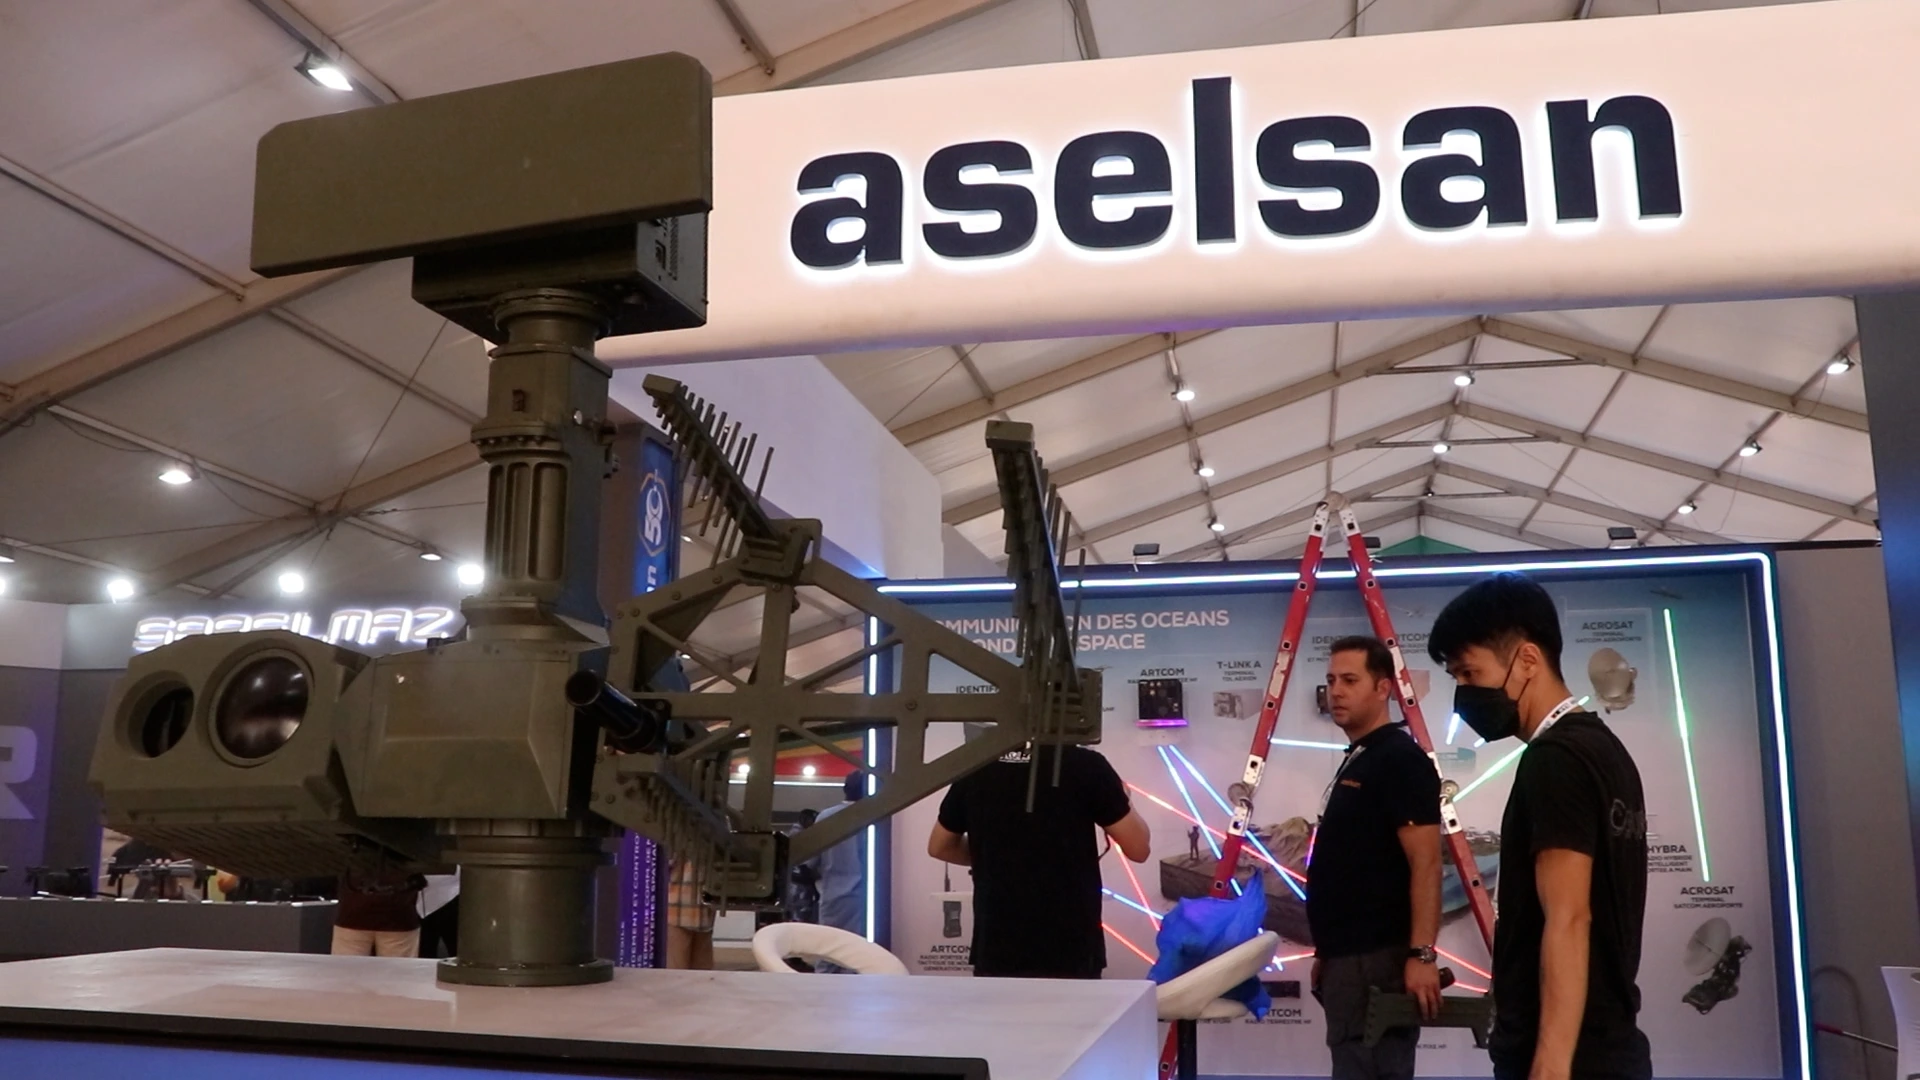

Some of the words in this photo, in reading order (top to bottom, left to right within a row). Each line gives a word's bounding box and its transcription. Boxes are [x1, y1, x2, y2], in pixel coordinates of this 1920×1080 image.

[789, 76, 1682, 269] aselsan
[1097, 613, 1137, 630] DES
[1141, 609, 1229, 629] OCEANS
[1582, 621, 1633, 630] ACROSAT
[1076, 633, 1146, 651] SPACE
[1217, 661, 1252, 669] T-LINK
[1253, 660, 1262, 668] A
[1140, 668, 1184, 676] ARTCOM
[1680, 886, 1735, 895] ACROSAT
